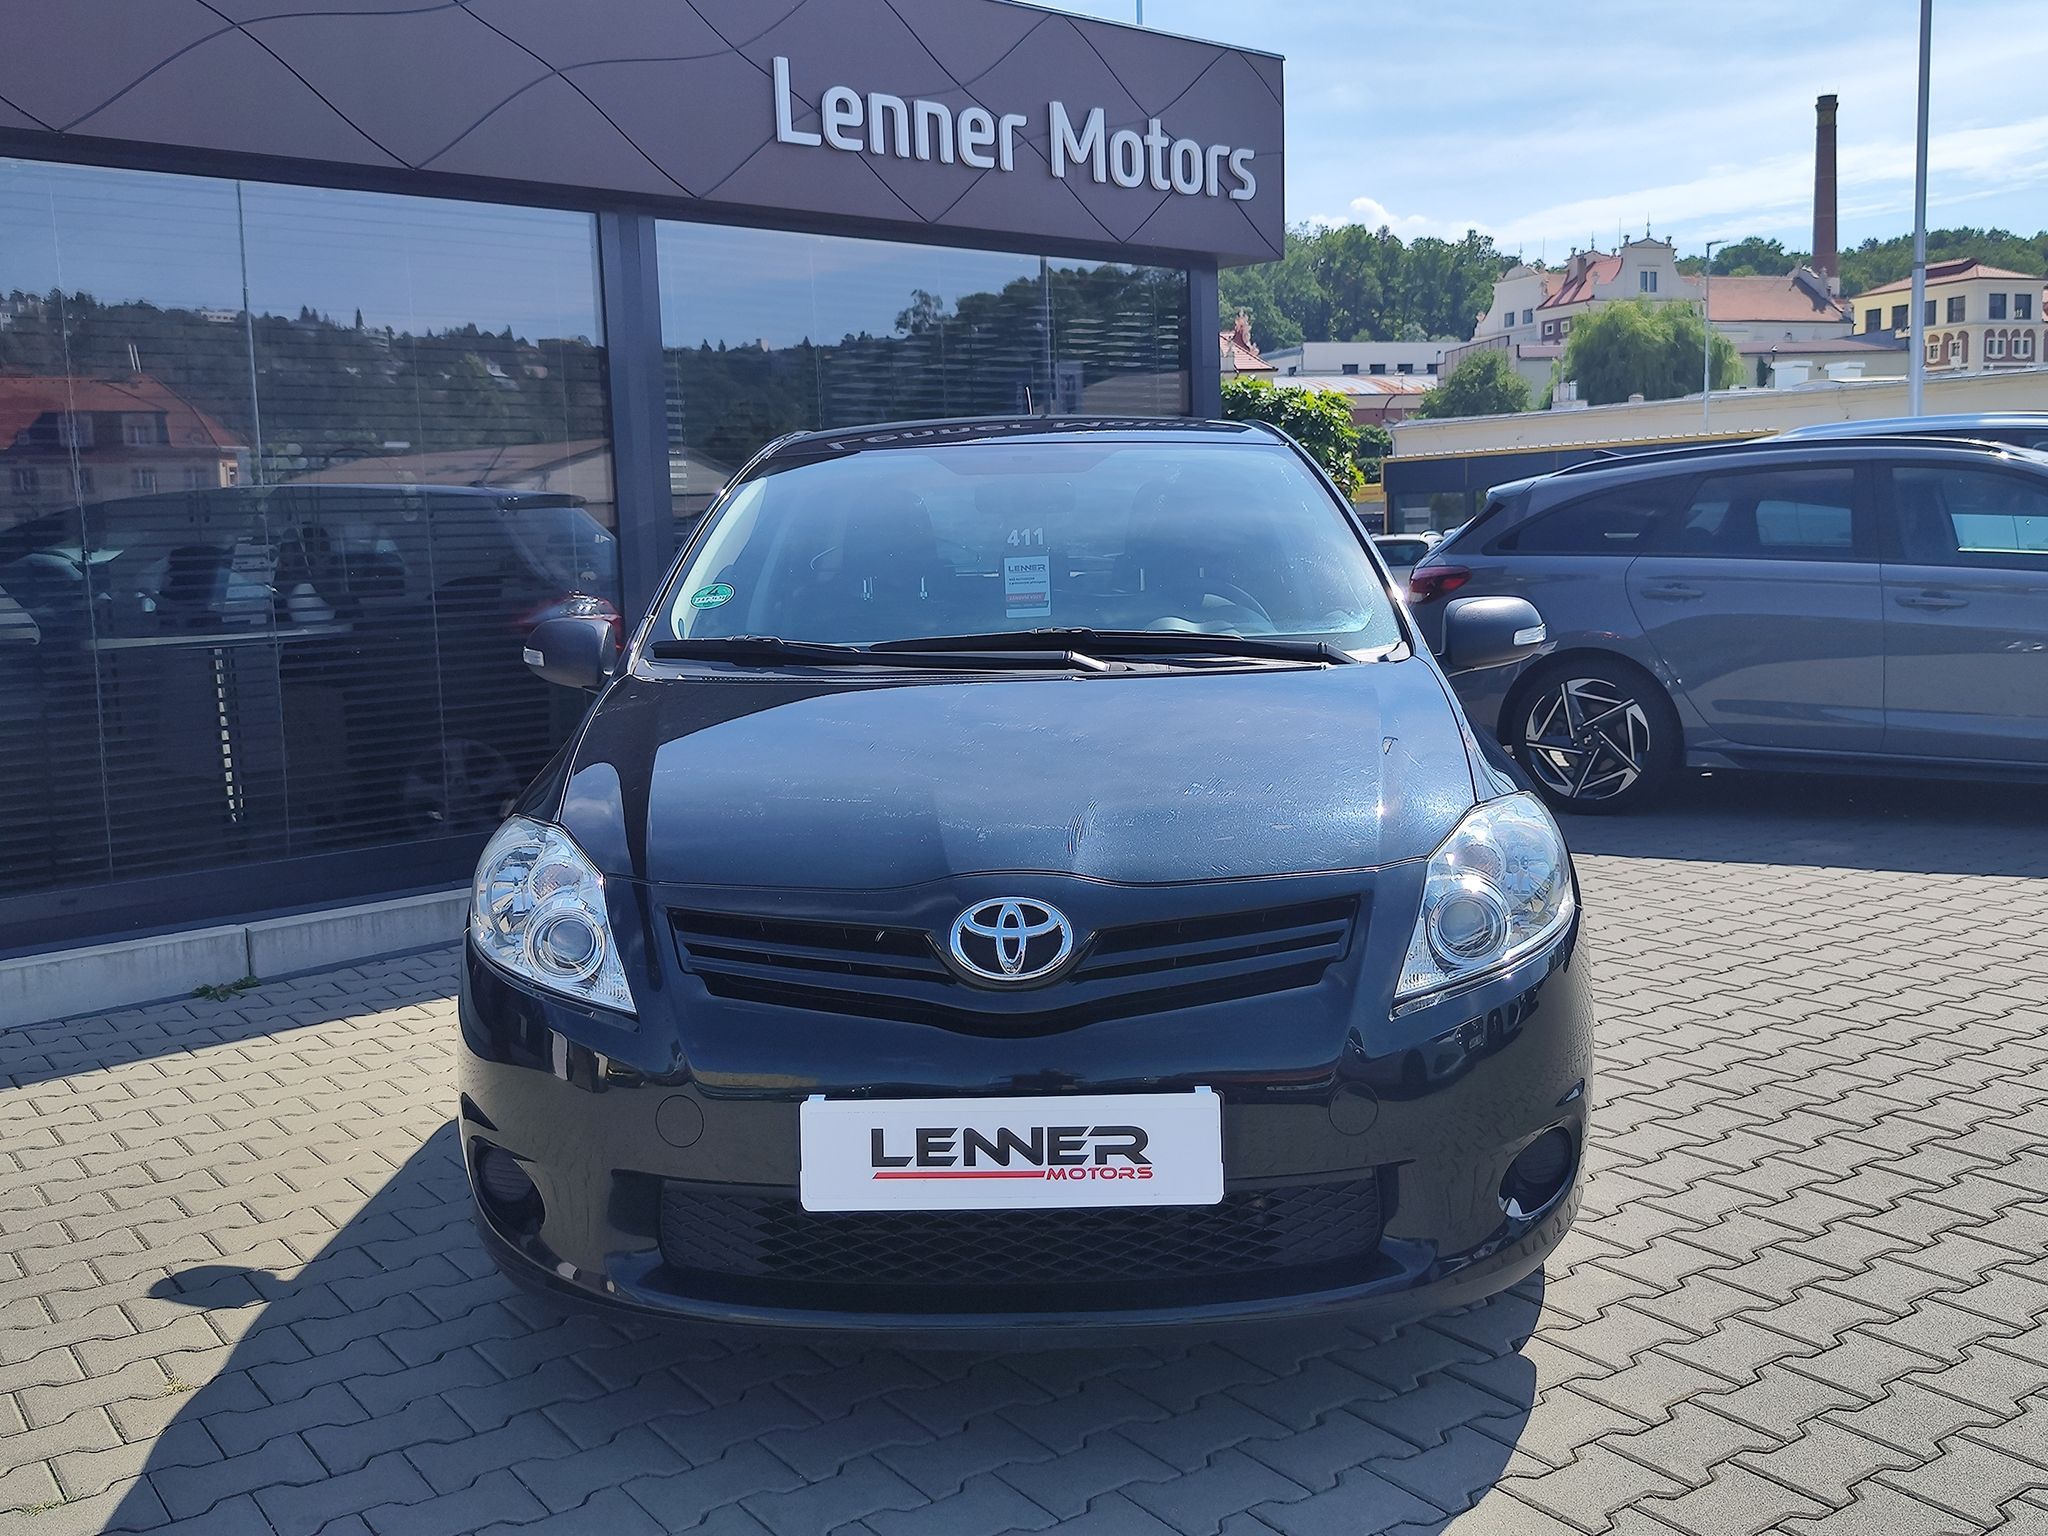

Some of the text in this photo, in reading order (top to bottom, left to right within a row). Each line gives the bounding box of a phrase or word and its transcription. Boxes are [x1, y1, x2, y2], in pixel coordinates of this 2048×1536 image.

[773, 56, 1258, 201] Lenner Motors
[1007, 527, 1044, 547] 411
[1008, 563, 1047, 573] LENNER
[871, 1125, 1153, 1168] LENNER
[1046, 1166, 1154, 1181] MOTORS
